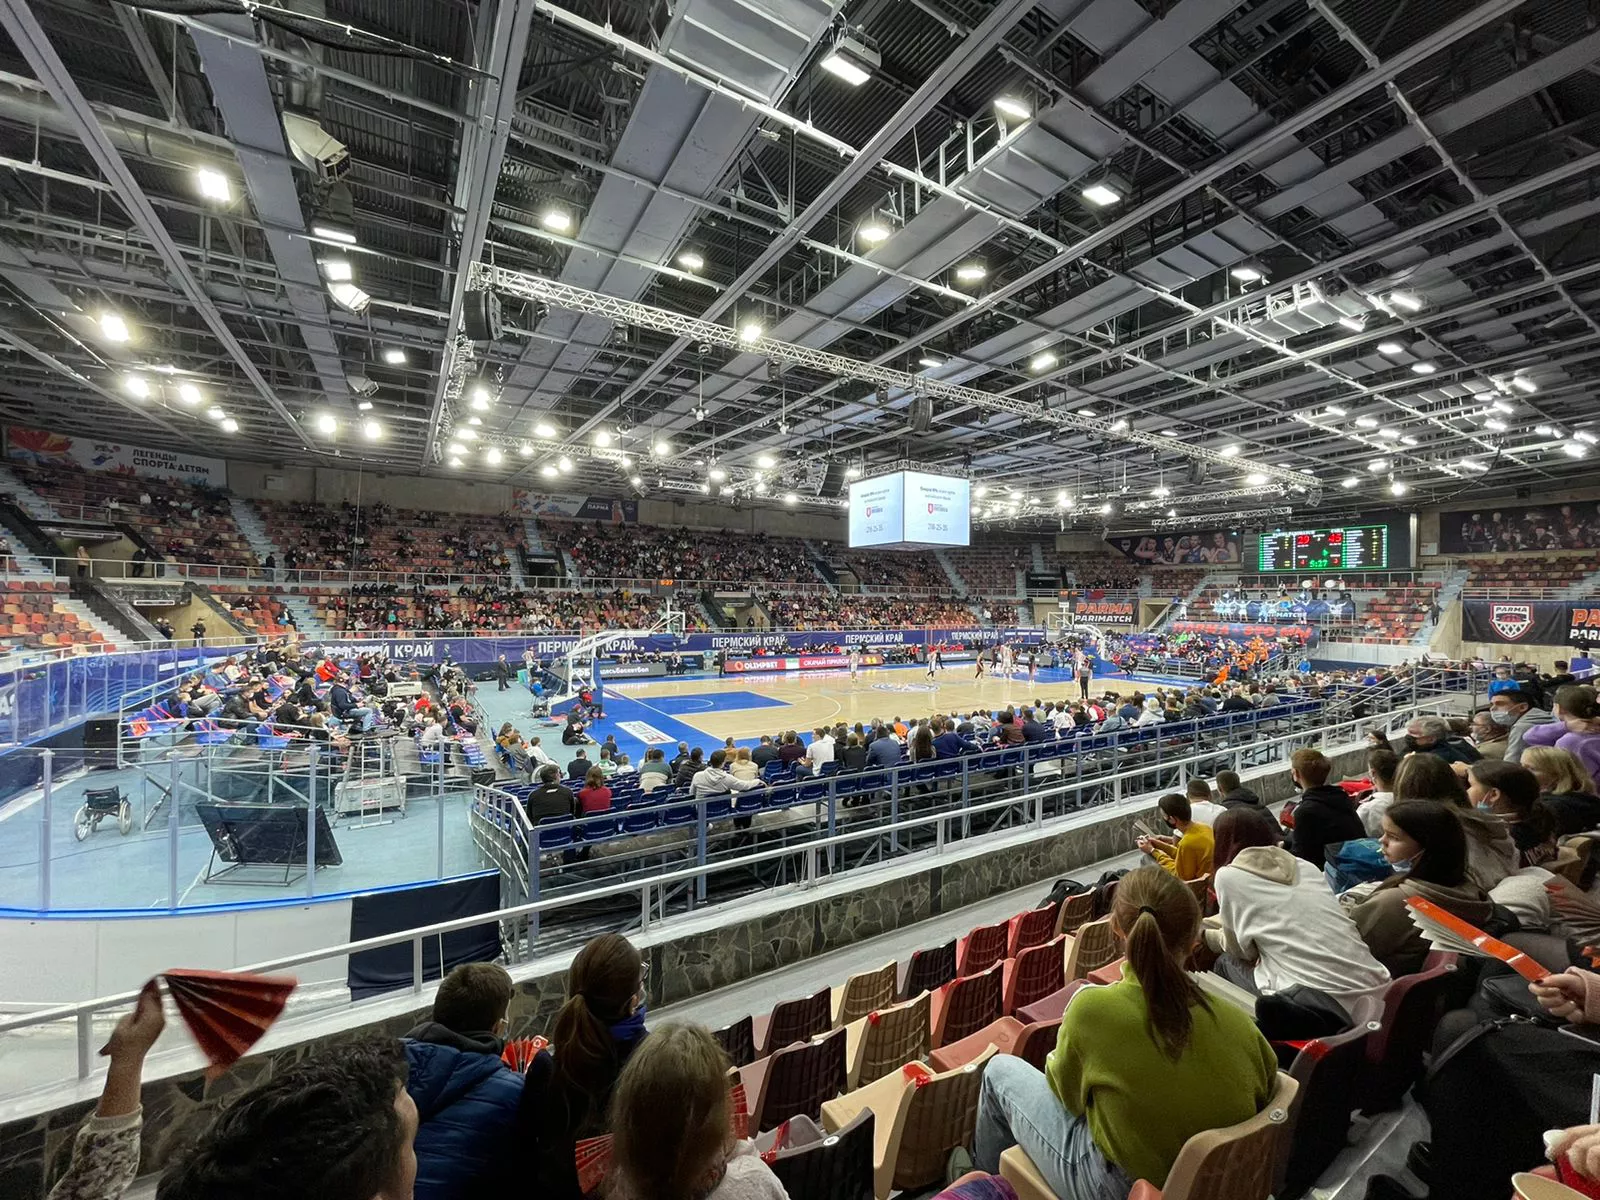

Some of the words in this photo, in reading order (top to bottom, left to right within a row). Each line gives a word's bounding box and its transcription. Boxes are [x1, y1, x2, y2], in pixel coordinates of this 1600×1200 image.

[133, 449, 177, 461] ЛЕГЕНДЫ
[1297, 535, 1310, 544] 29
[1075, 602, 1133, 615] PARMA
[1074, 615, 1132, 623] PARIMATCH
[712, 634, 761, 648] ПЕРМСКИЙ
[763, 634, 786, 646] КРАЙ
[845, 632, 884, 644] ПЕРМСКИЙ
[885, 632, 904, 642] КРАЙ
[395, 641, 433, 658] КРАЙ
[605, 637, 635, 652] КРАЙ
[744, 661, 777, 669] OLIMPBET
[803, 658, 825, 667] СКАЧАЙ
